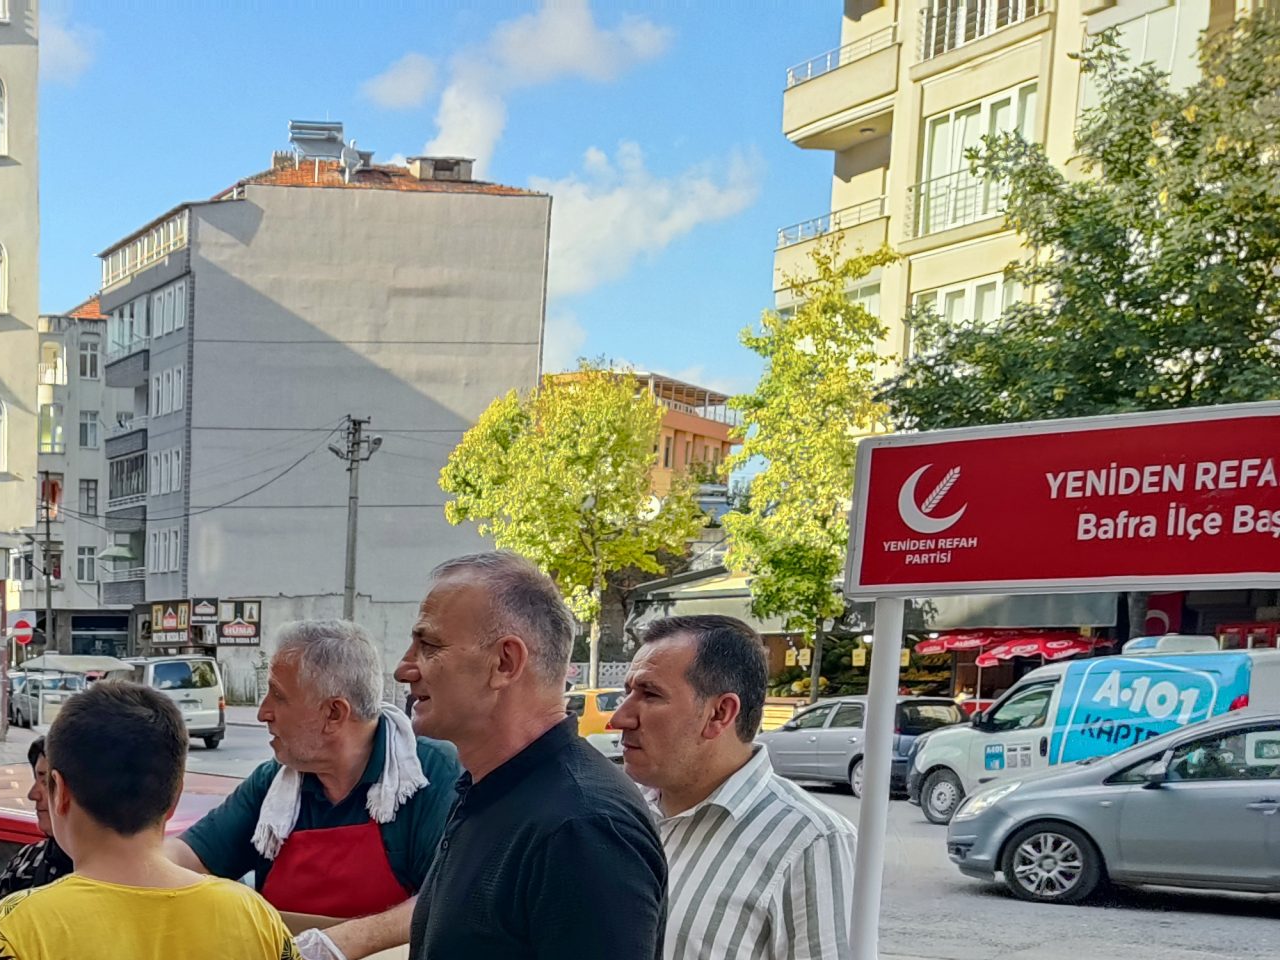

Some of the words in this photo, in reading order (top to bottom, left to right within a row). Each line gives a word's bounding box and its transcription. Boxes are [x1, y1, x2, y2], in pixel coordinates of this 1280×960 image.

[1045, 462, 1186, 499] YENİDEN
[1194, 457, 1280, 492] REFA
[1076, 510, 1156, 541] Bafra
[1166, 502, 1222, 542] İlçe
[883, 538, 936, 552] YENİDEN
[937, 536, 978, 550] REFAH
[904, 550, 952, 565] PARTİSİ
